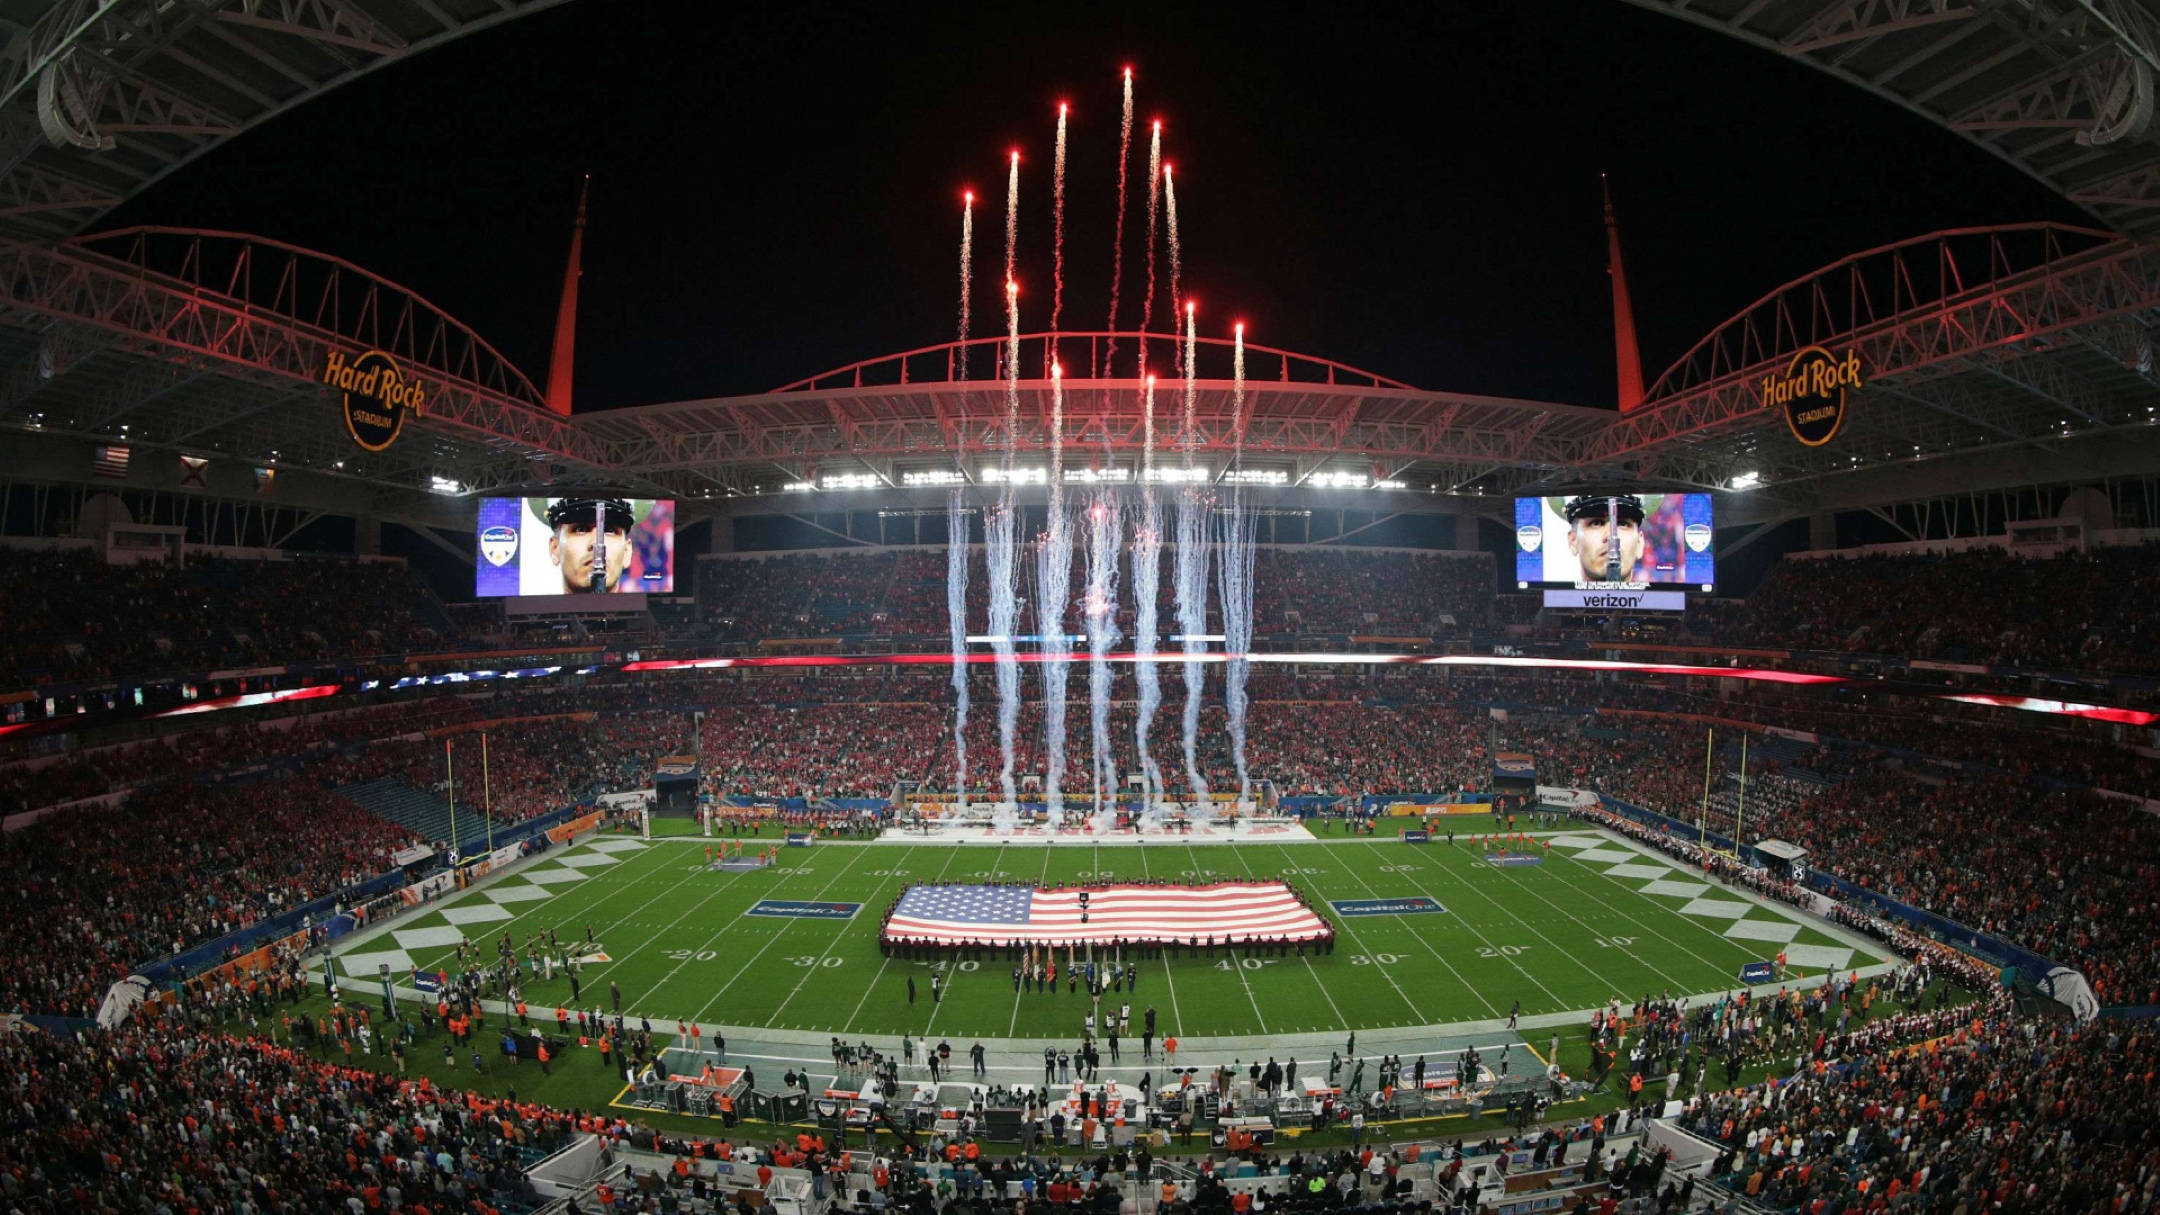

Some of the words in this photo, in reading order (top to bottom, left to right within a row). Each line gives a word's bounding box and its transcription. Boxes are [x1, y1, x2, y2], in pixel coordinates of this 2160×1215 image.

[325, 352, 380, 396] Hard
[379, 368, 425, 416] Rock
[1762, 363, 1808, 408] Hard
[1811, 348, 1861, 398] Rock
[354, 409, 392, 429] STADIUM
[1797, 406, 1836, 424] STADIUM
[1583, 593, 1638, 607] verizon
[1593, 936, 1633, 948] 10
[667, 949, 717, 962] 20
[1475, 945, 1523, 958] 20
[793, 955, 844, 968] 30
[931, 959, 981, 972] 40
[1213, 957, 1262, 971] 40
[1349, 953, 1398, 966] 30
